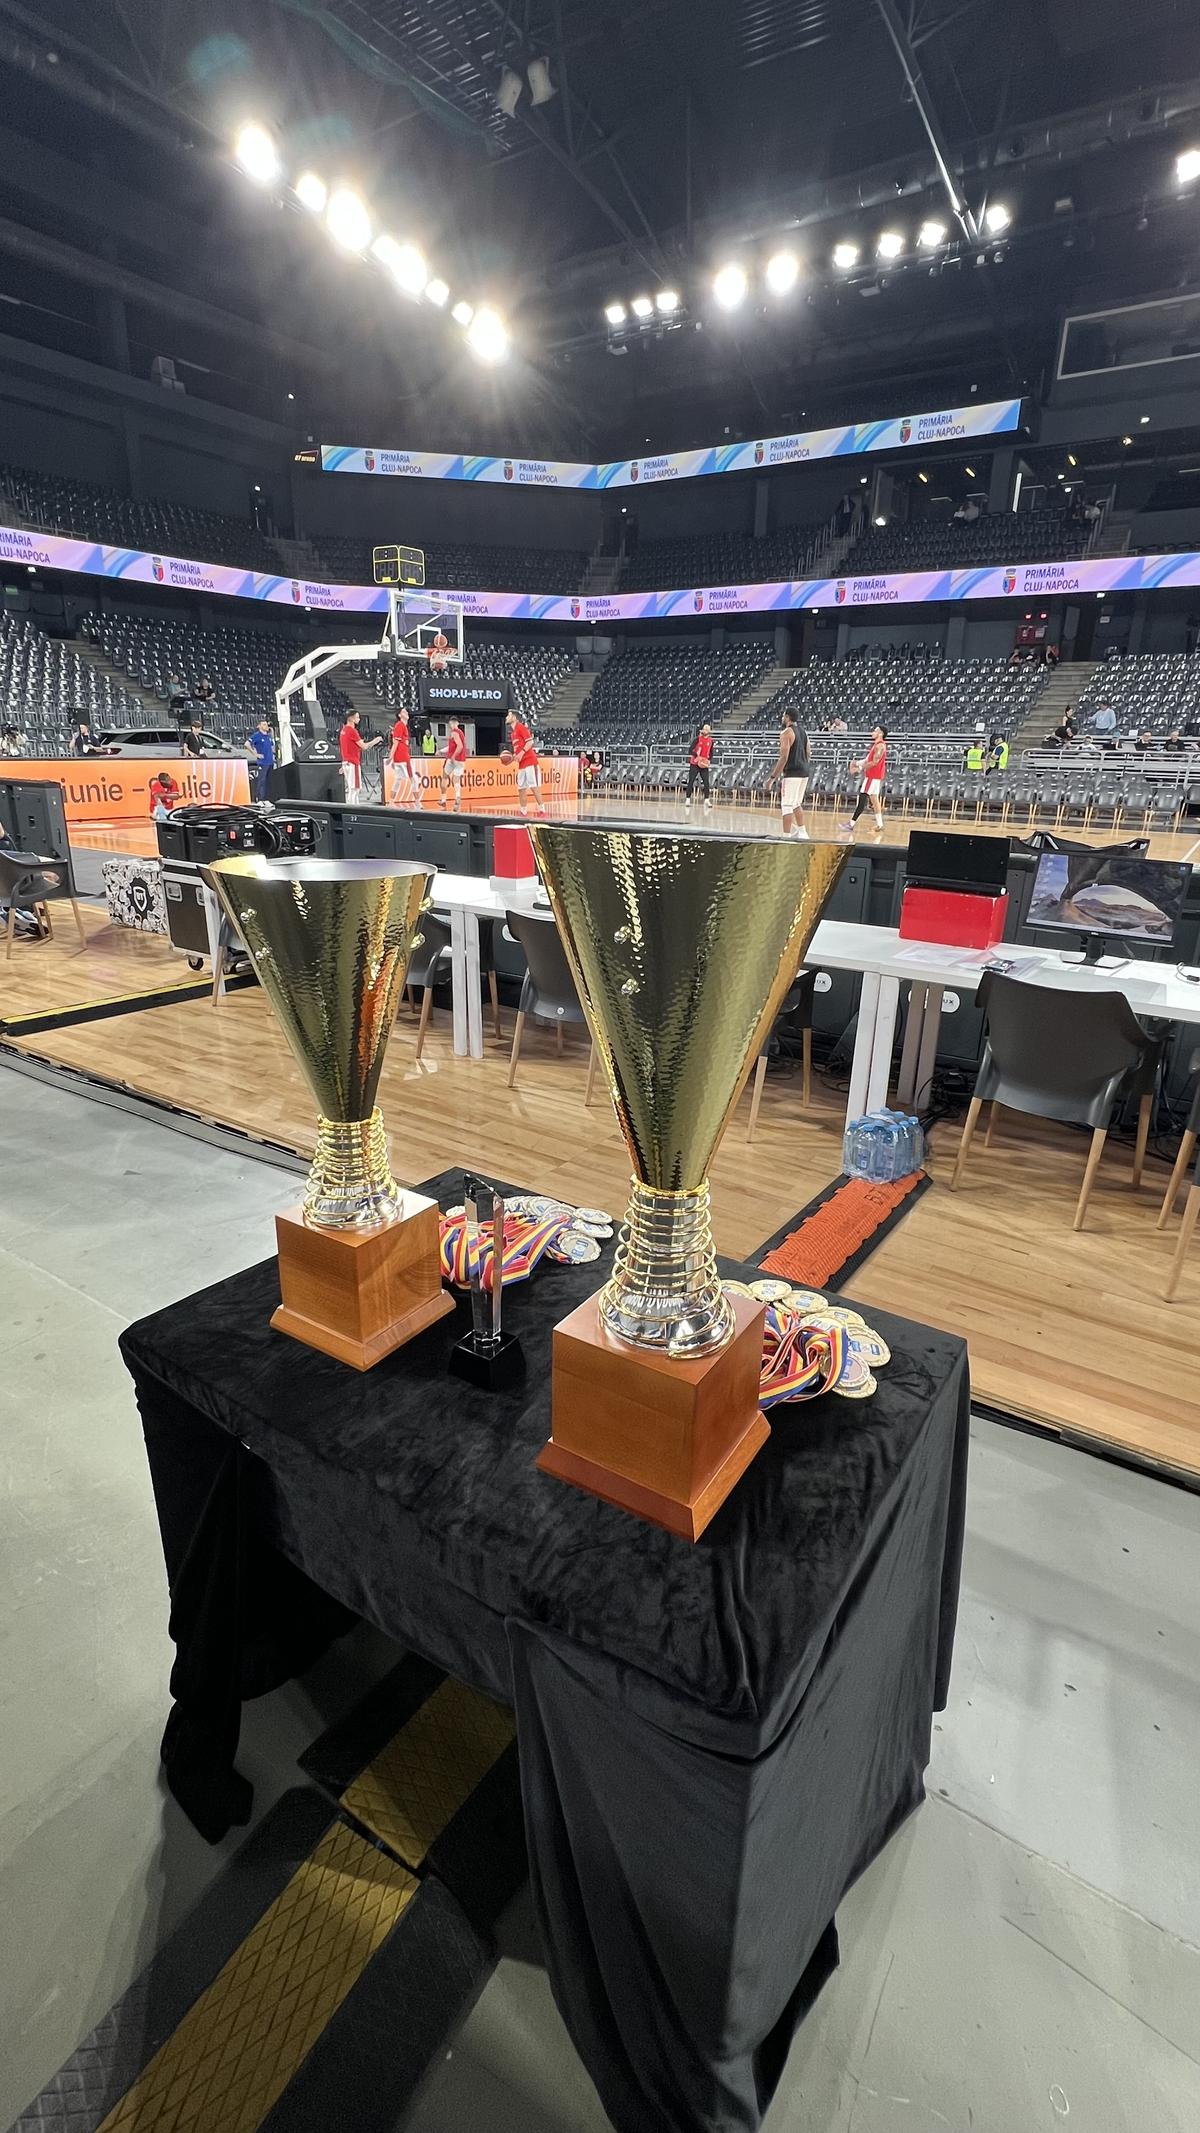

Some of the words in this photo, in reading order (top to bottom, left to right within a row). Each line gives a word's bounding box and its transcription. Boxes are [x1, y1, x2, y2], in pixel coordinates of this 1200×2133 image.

[918, 414, 953, 428] PRIMĂRIA
[917, 425, 965, 440] CLUJ-NAPOCA
[770, 438, 799, 450] PRIMĂRIA
[381, 453, 410, 463] PRIMĂRIA
[769, 448, 810, 462] CLUJ-NAPOCA
[381, 464, 422, 474] CLUJ-NAPOCA
[519, 463, 547, 473] PRIMĂRIA
[643, 458, 669, 469] PRIMĂRIA
[519, 473, 558, 483] CLUJ-NAPOCA
[643, 468, 679, 480] CLUJ-NAPOCA
[170, 562, 201, 575] PRIMĂRIA
[1025, 567, 1065, 579] PRIMĂRIA
[171, 573, 214, 589] CLUJ-NAPOCA
[853, 579, 887, 590] PRIMĂRIA
[1024, 579, 1079, 592] CLUJ-NAPOCA
[305, 585, 331, 597] PRIMĂRIA
[709, 589, 737, 600] PRIMĂRIA
[852, 591, 898, 602] CLUJ-NAPOCA
[305, 596, 344, 608] CLUJ-NAPOCA
[586, 599, 611, 608] PRIMĂRIA
[708, 600, 748, 611] CLUJ-NAPOCA
[586, 608, 621, 618] CLUJ-NAPOCA
[429, 688, 502, 699] SHOP.U-BT.RO
[487, 770, 494, 786] 8
[61, 777, 123, 803] iunie
